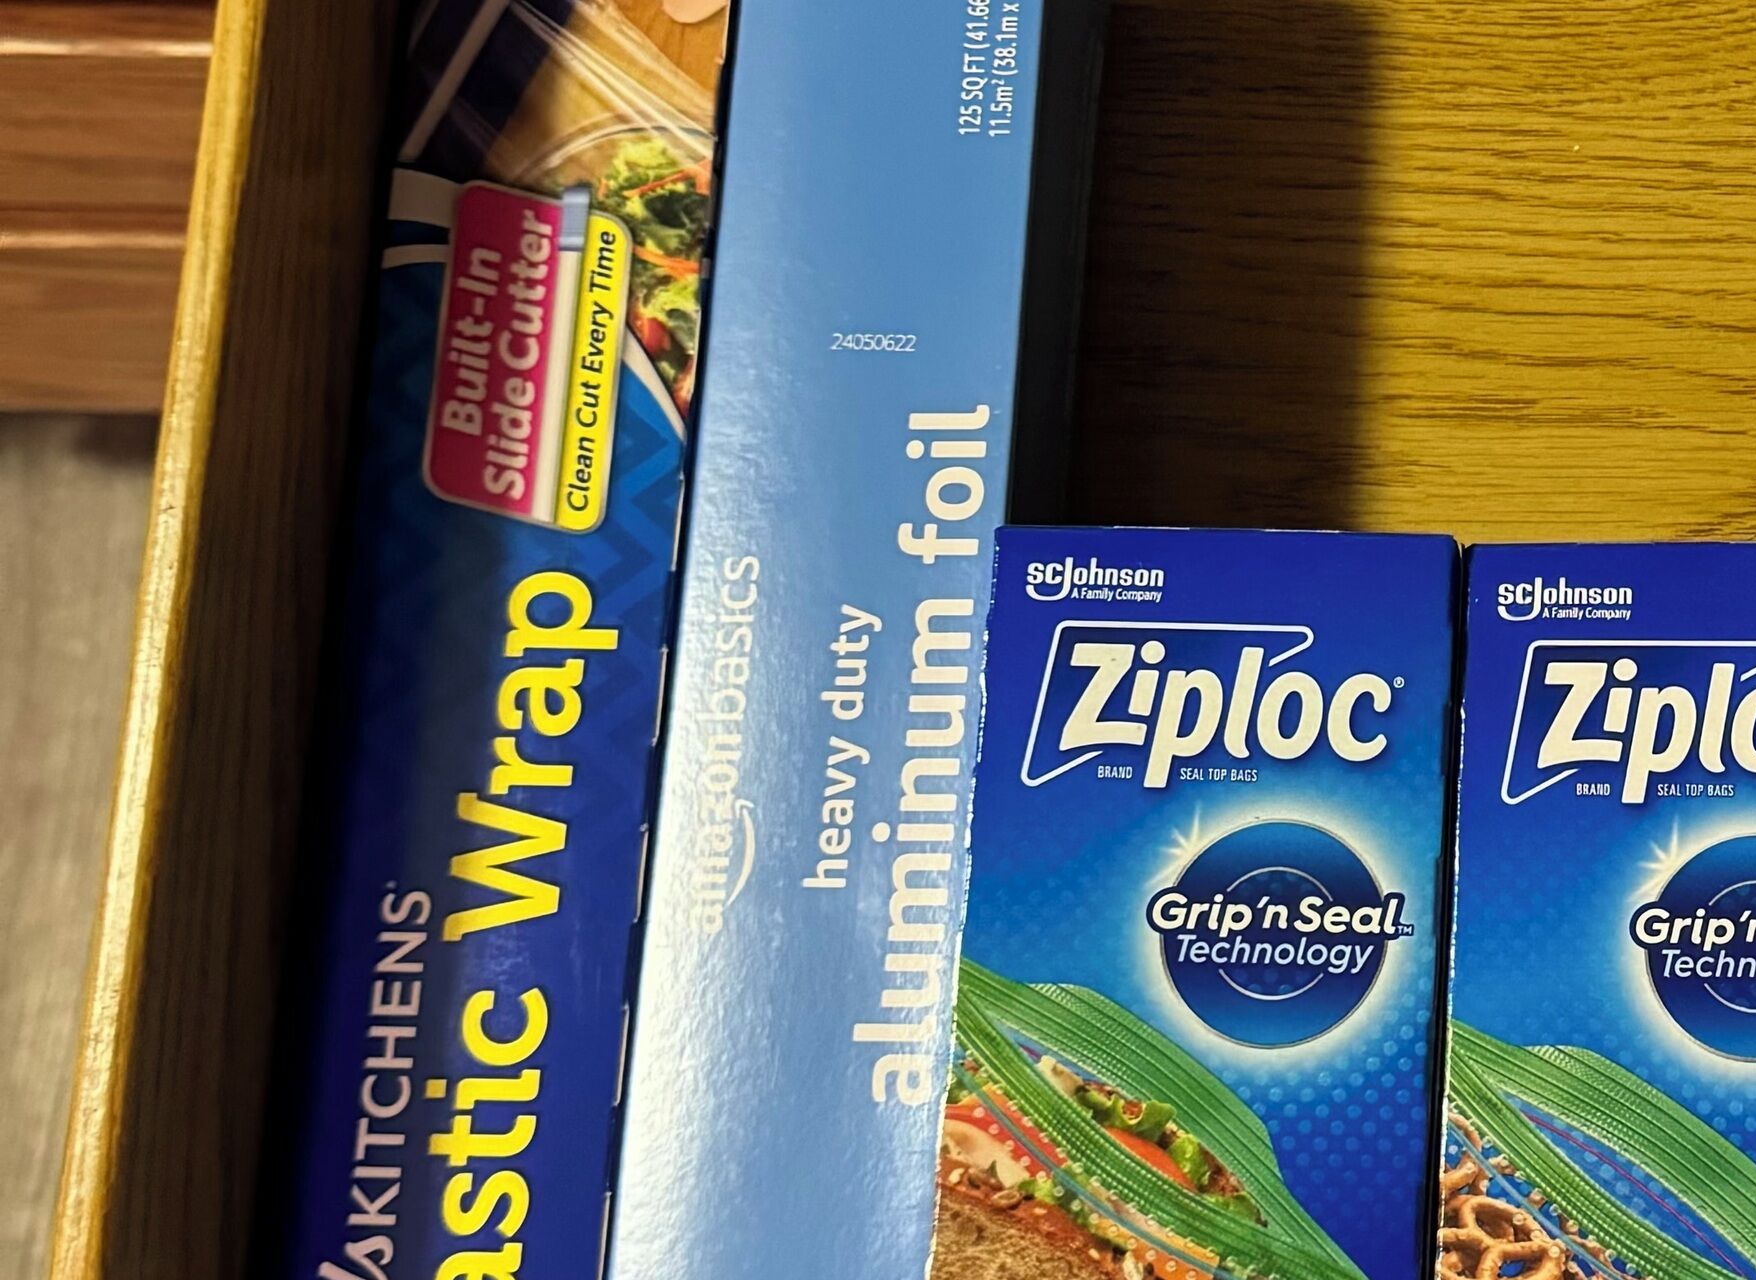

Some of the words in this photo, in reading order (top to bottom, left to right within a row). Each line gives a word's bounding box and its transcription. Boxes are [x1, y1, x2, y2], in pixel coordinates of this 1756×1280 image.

[961, 75, 988, 100] SQ
[963, 53, 987, 74] FT
[958, 105, 982, 136] 125
[591, 229, 617, 280] Time
[499, 209, 556, 382] Cutter
[443, 246, 503, 437] Built-In
[581, 284, 610, 368] Every
[829, 332, 917, 352] 24050622
[576, 372, 600, 425] Cut
[484, 388, 532, 501] Slide
[566, 433, 594, 514] Clean
[897, 403, 991, 561] foil
[1081, 587, 1113, 602] Family
[1116, 588, 1162, 603] Company
[1552, 606, 1584, 620] Family
[1585, 606, 1631, 621] Company
[821, 603, 882, 721] duty
[443, 571, 619, 942] Wrap
[1097, 765, 1132, 779] BRAND
[804, 734, 871, 890] heavy
[1576, 783, 1611, 797] BRAND
[854, 595, 975, 1108] aluminum
[1176, 934, 1374, 975] Technology
